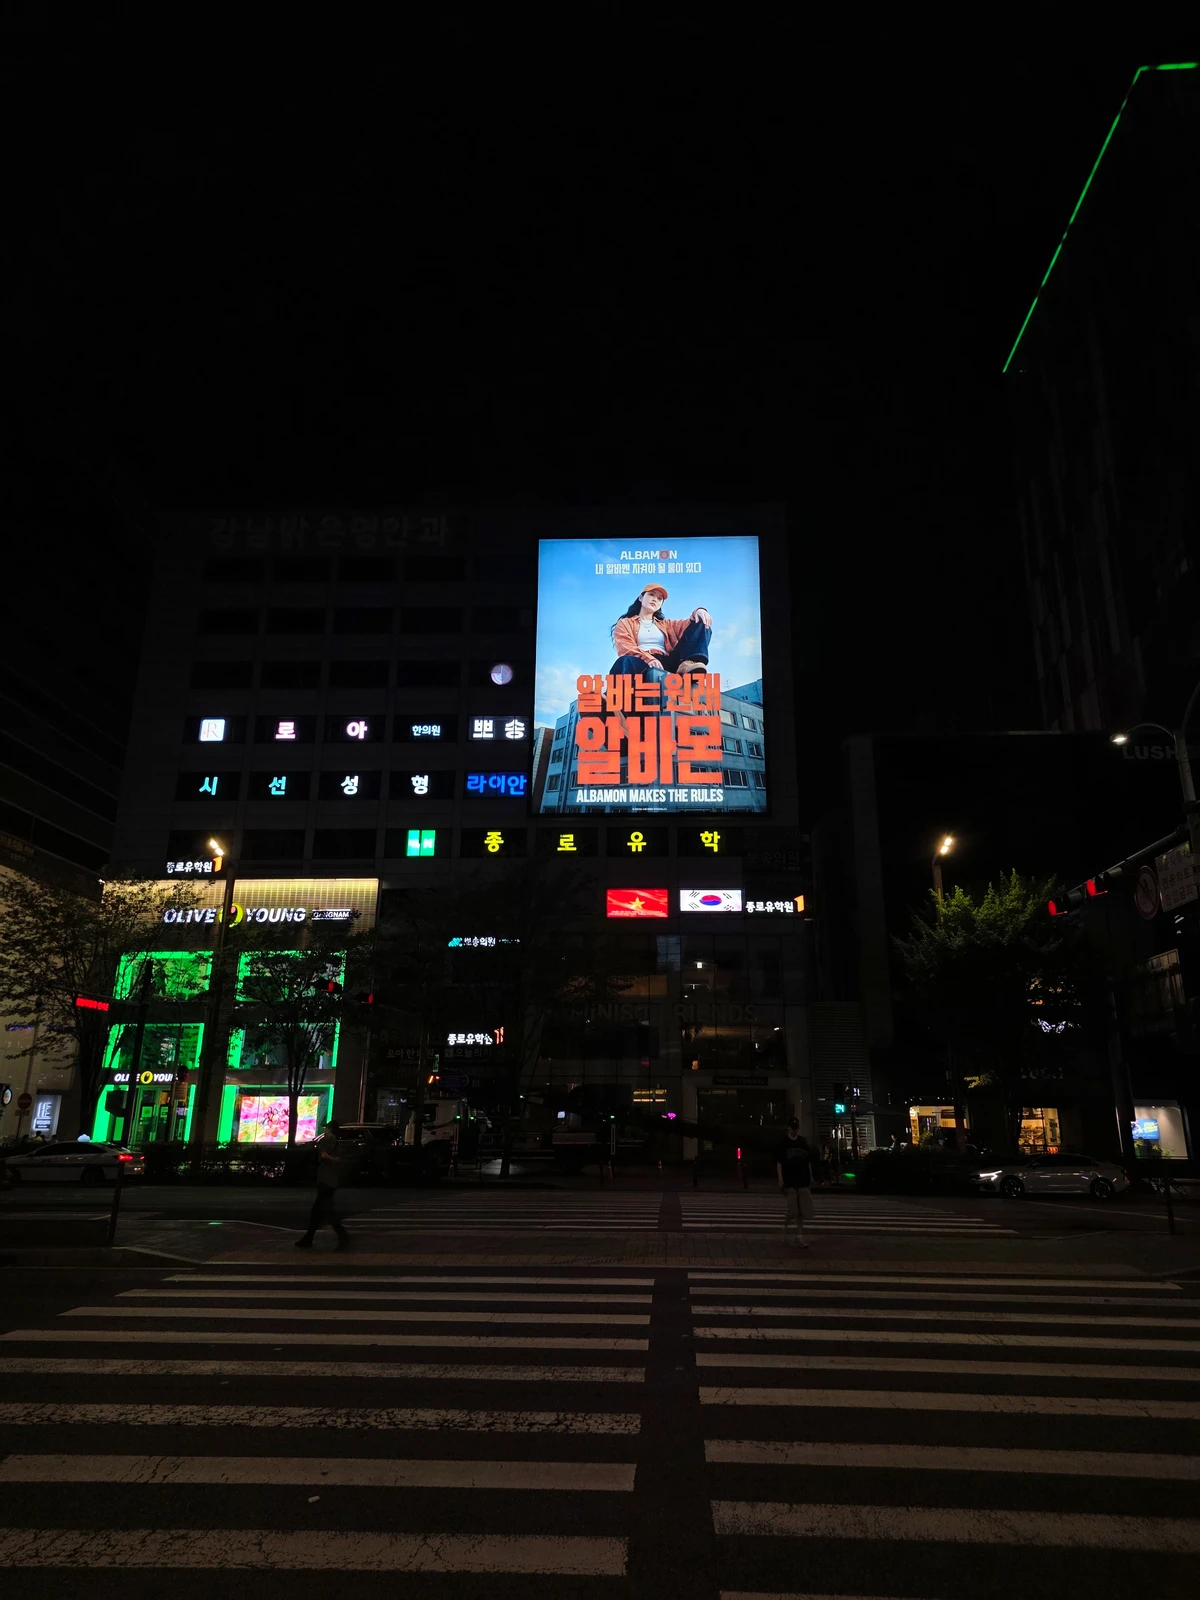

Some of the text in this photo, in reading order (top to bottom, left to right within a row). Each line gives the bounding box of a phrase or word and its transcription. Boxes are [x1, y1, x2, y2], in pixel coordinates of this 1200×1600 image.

[620, 550, 677, 560] ALBAMON
[595, 563, 604, 575] 내
[606, 563, 630, 575] 알바엔
[632, 563, 656, 574] 지켜야
[686, 562, 702, 573] 있다
[576, 673, 721, 712] 알바는 원래
[412, 725, 441, 737] 한의원
[576, 716, 723, 785] 알바몬
[466, 775, 528, 796] 라이안
[576, 788, 724, 803] ALBAMON MAKES THE RULES
[745, 901, 794, 913] 종로유학원
[163, 907, 306, 923] OLIVE YOUNG
[659, 1002, 757, 1024] RIENDS
